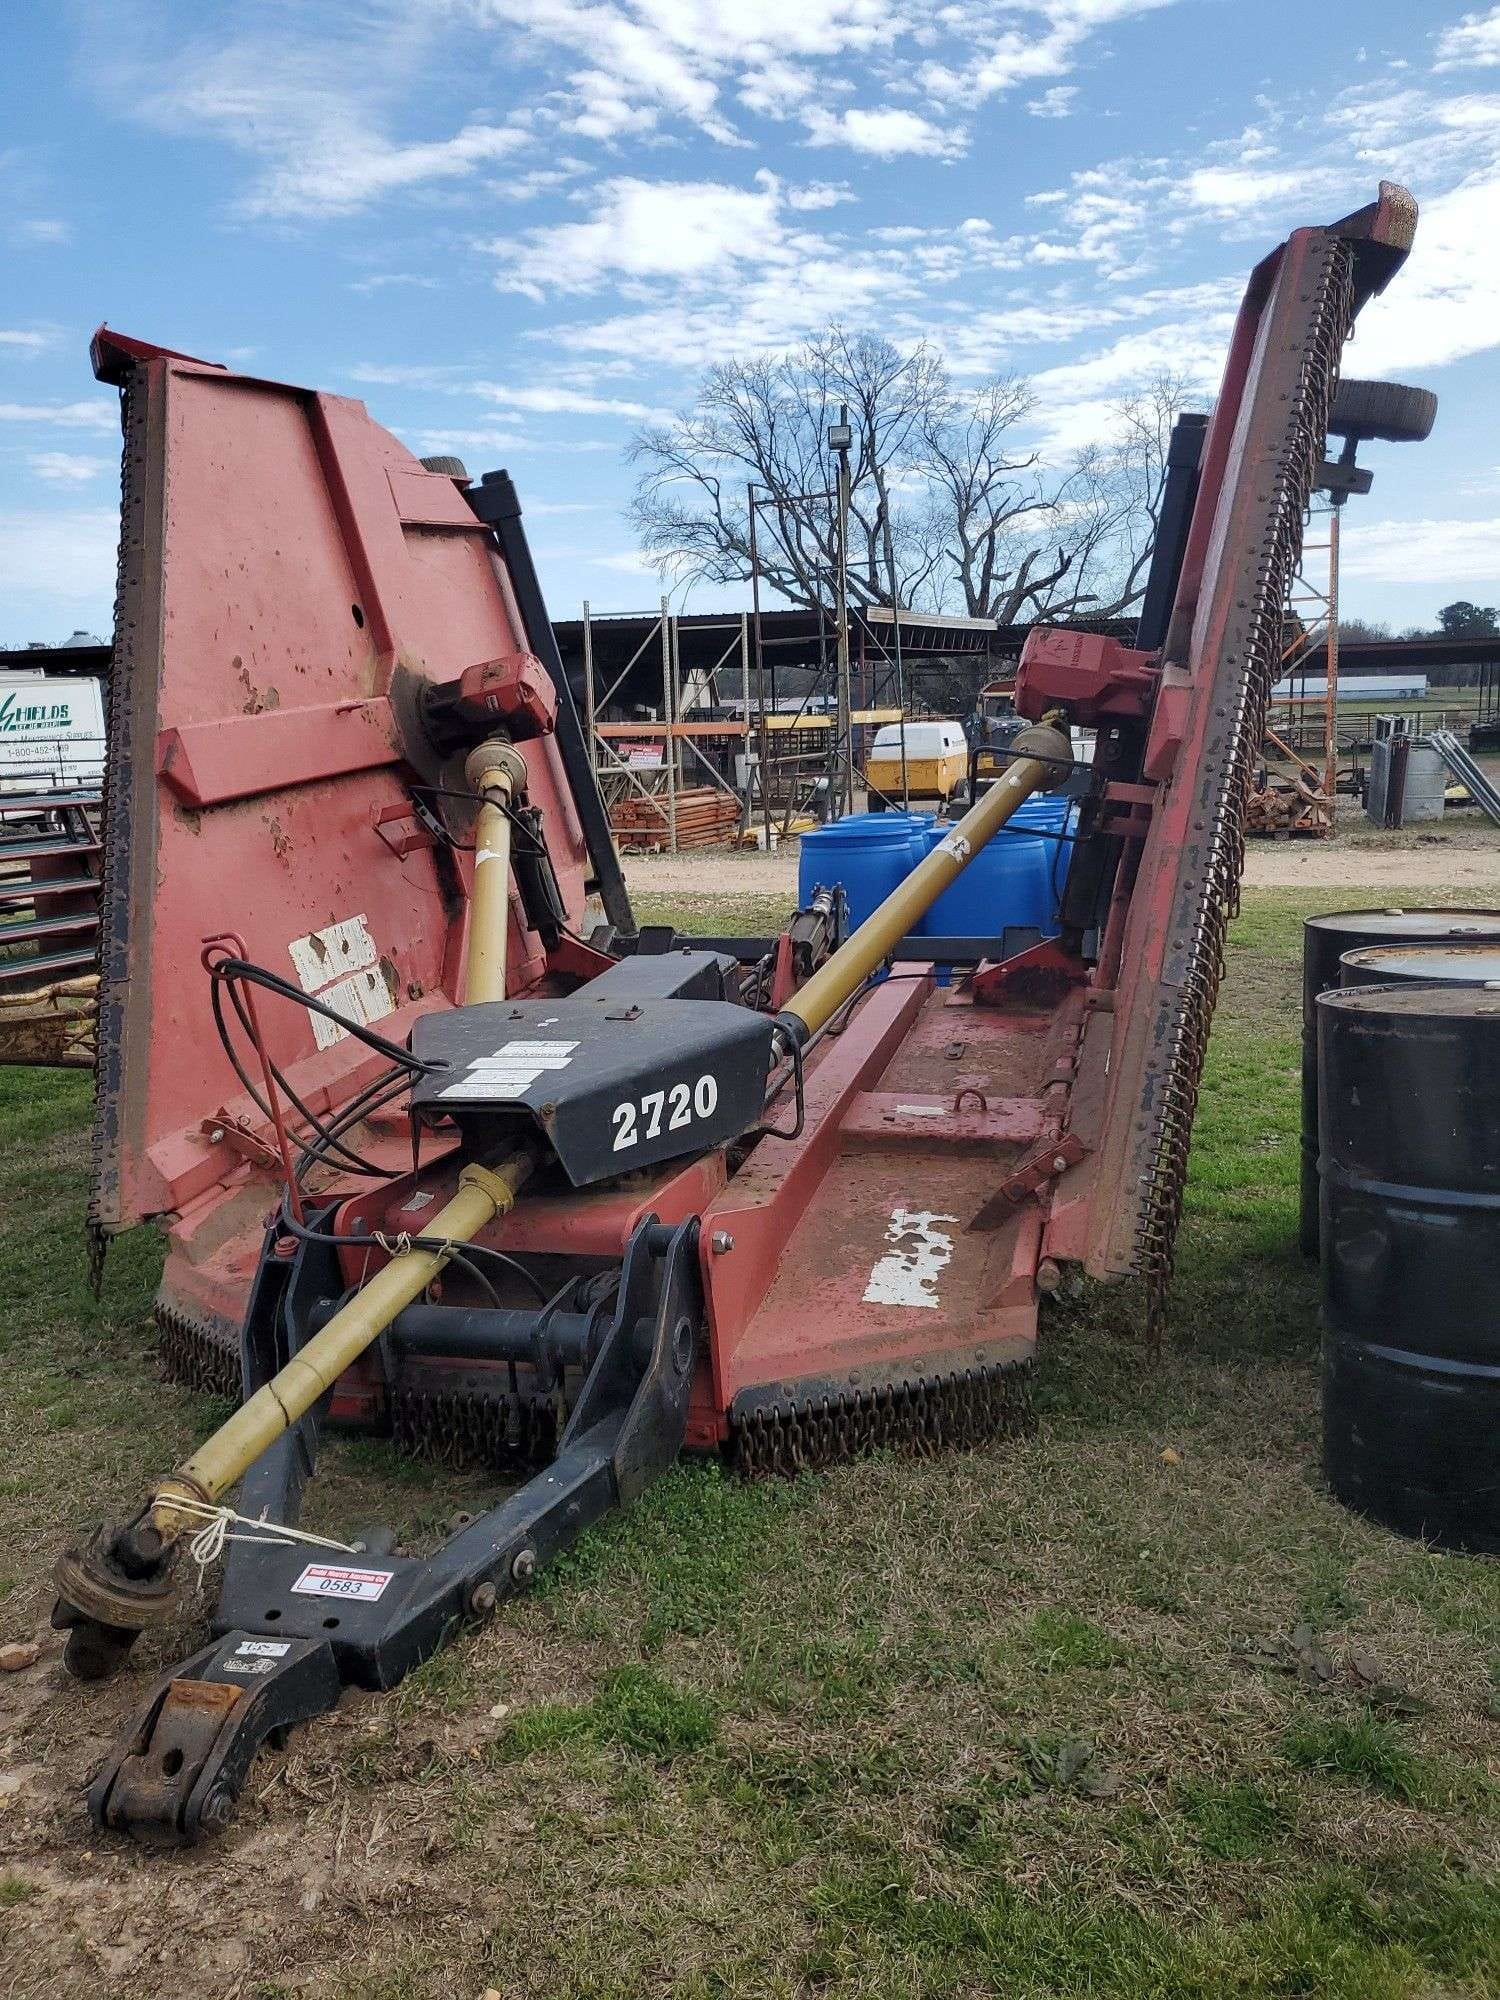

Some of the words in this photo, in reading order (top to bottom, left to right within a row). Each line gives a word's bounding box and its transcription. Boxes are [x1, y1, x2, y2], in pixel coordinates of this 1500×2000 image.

[0, 693, 69, 731] SHIELDS
[613, 1074, 718, 1152] 2720
[320, 1579, 362, 1593] 0583
